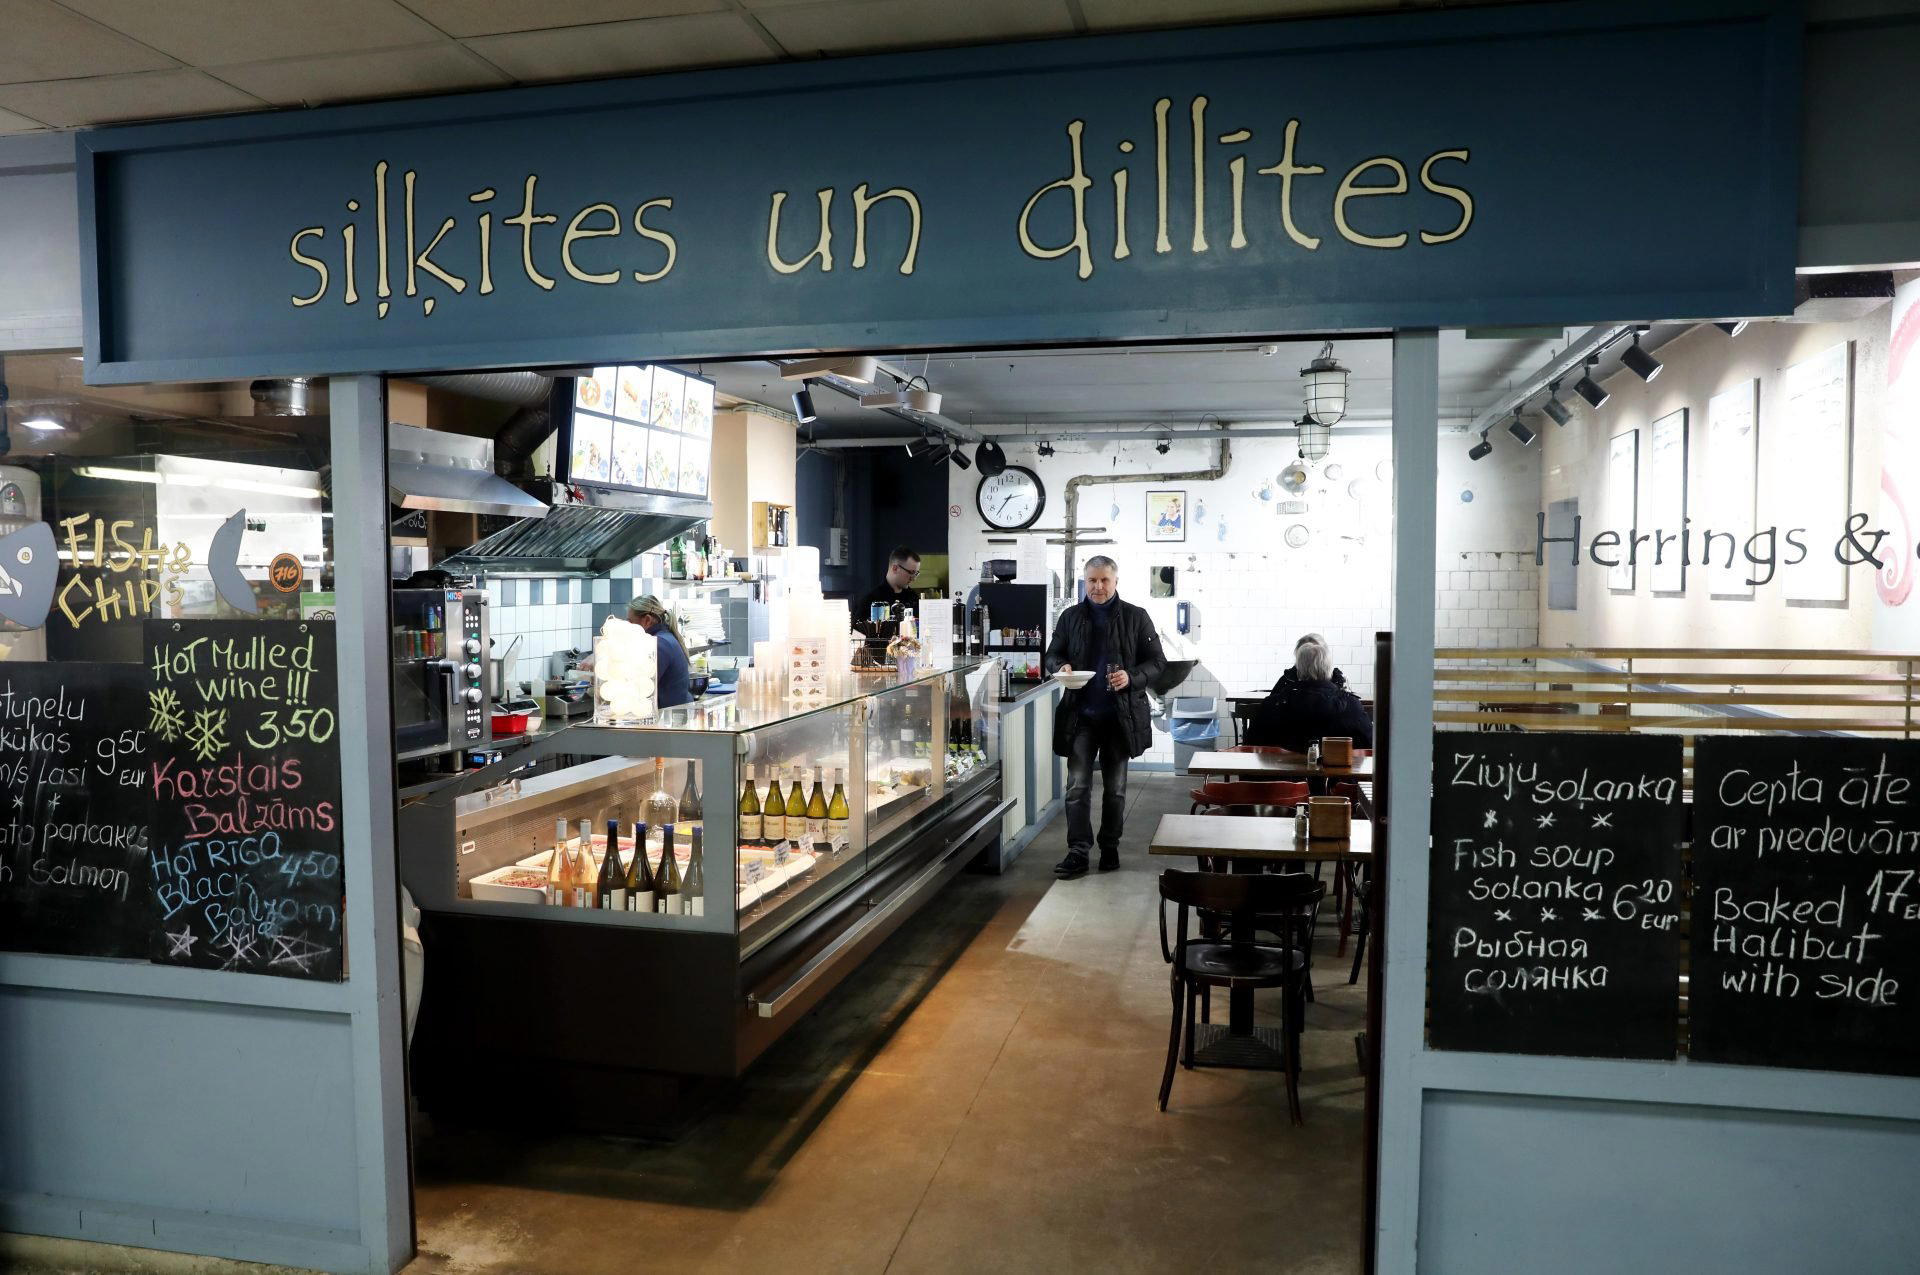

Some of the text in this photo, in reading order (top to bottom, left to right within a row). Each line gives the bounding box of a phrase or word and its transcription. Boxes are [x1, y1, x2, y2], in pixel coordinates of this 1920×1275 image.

[765, 183, 922, 275] un
[1017, 95, 1474, 280] dillītes
[60, 512, 193, 574] FISH &
[1535, 511, 1891, 586] Herrings &
[58, 573, 185, 629] CHIPS
[212, 634, 319, 672] Mulled
[245, 708, 335, 749] 3.50
[153, 751, 302, 800] Karstais
[1719, 759, 1823, 817] Cepta
[1454, 838, 1517, 871] Fish
[1710, 825, 1746, 849] ar
[1714, 885, 1845, 928] Baked
[1454, 927, 1589, 959] Рыбная
[1713, 922, 1882, 965] Halibut
[1722, 962, 1800, 997] with
